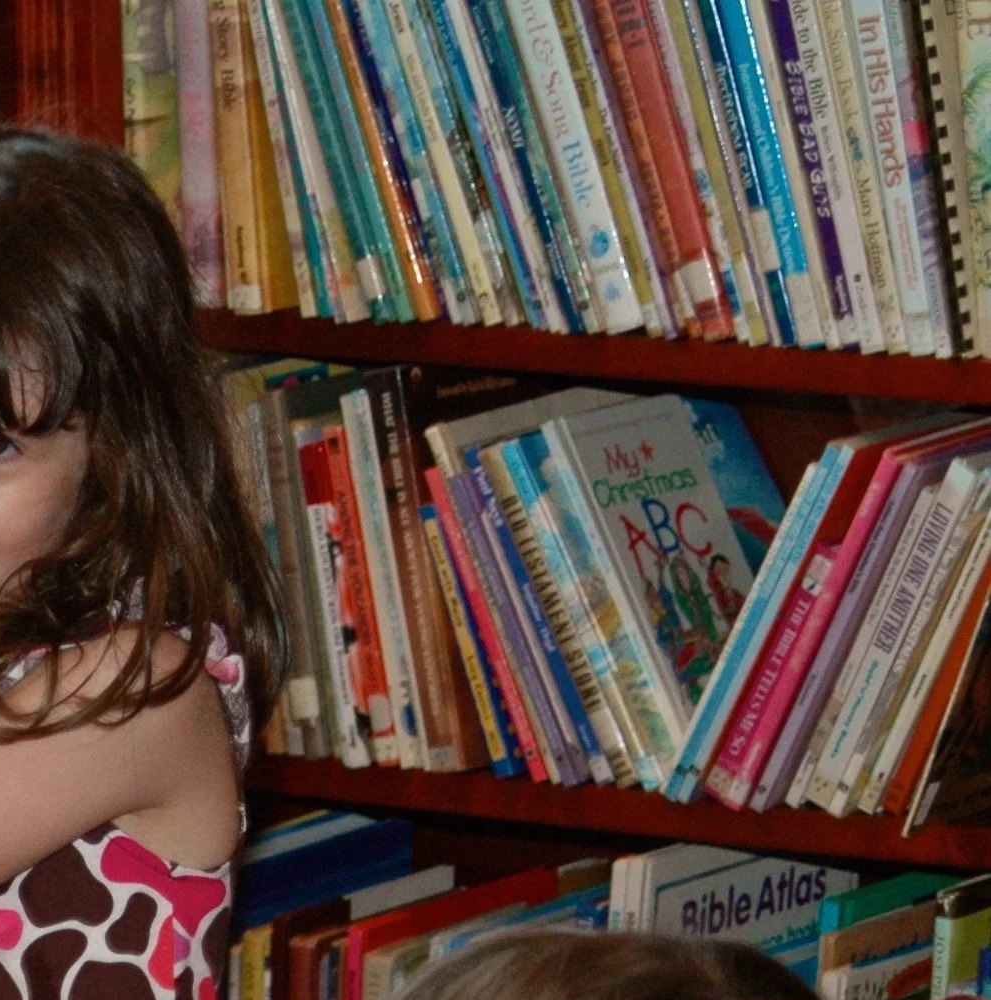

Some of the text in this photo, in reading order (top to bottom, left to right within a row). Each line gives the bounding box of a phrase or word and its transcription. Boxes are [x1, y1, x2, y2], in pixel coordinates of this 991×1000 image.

[529, 34, 557, 71] &
[797, 26, 812, 45] to
[823, 28, 850, 75] Story
[856, 13, 883, 44] In
[215, 16, 236, 111] Story Bible
[801, 46, 820, 74] the
[862, 46, 892, 94] His
[539, 68, 577, 139] Song
[806, 77, 830, 120] Bible
[836, 77, 859, 120] Book
[501, 103, 526, 149] NOAH
[783, 58, 834, 219] BIBLE BAD GUYS
[870, 96, 908, 188] Hands
[560, 139, 598, 209] Bible
[853, 177, 891, 289] Mary Hoffman
[604, 443, 641, 478] My
[593, 468, 698, 508] Christmas
[916, 501, 954, 557] LOVING
[516, 535, 576, 647] TESTAMENT
[902, 554, 930, 588] ONE
[872, 584, 917, 654] ANOTHER
[725, 597, 810, 757] THE BIBLE TELLS ME SO
[681, 865, 827, 936] Bible Atlas
